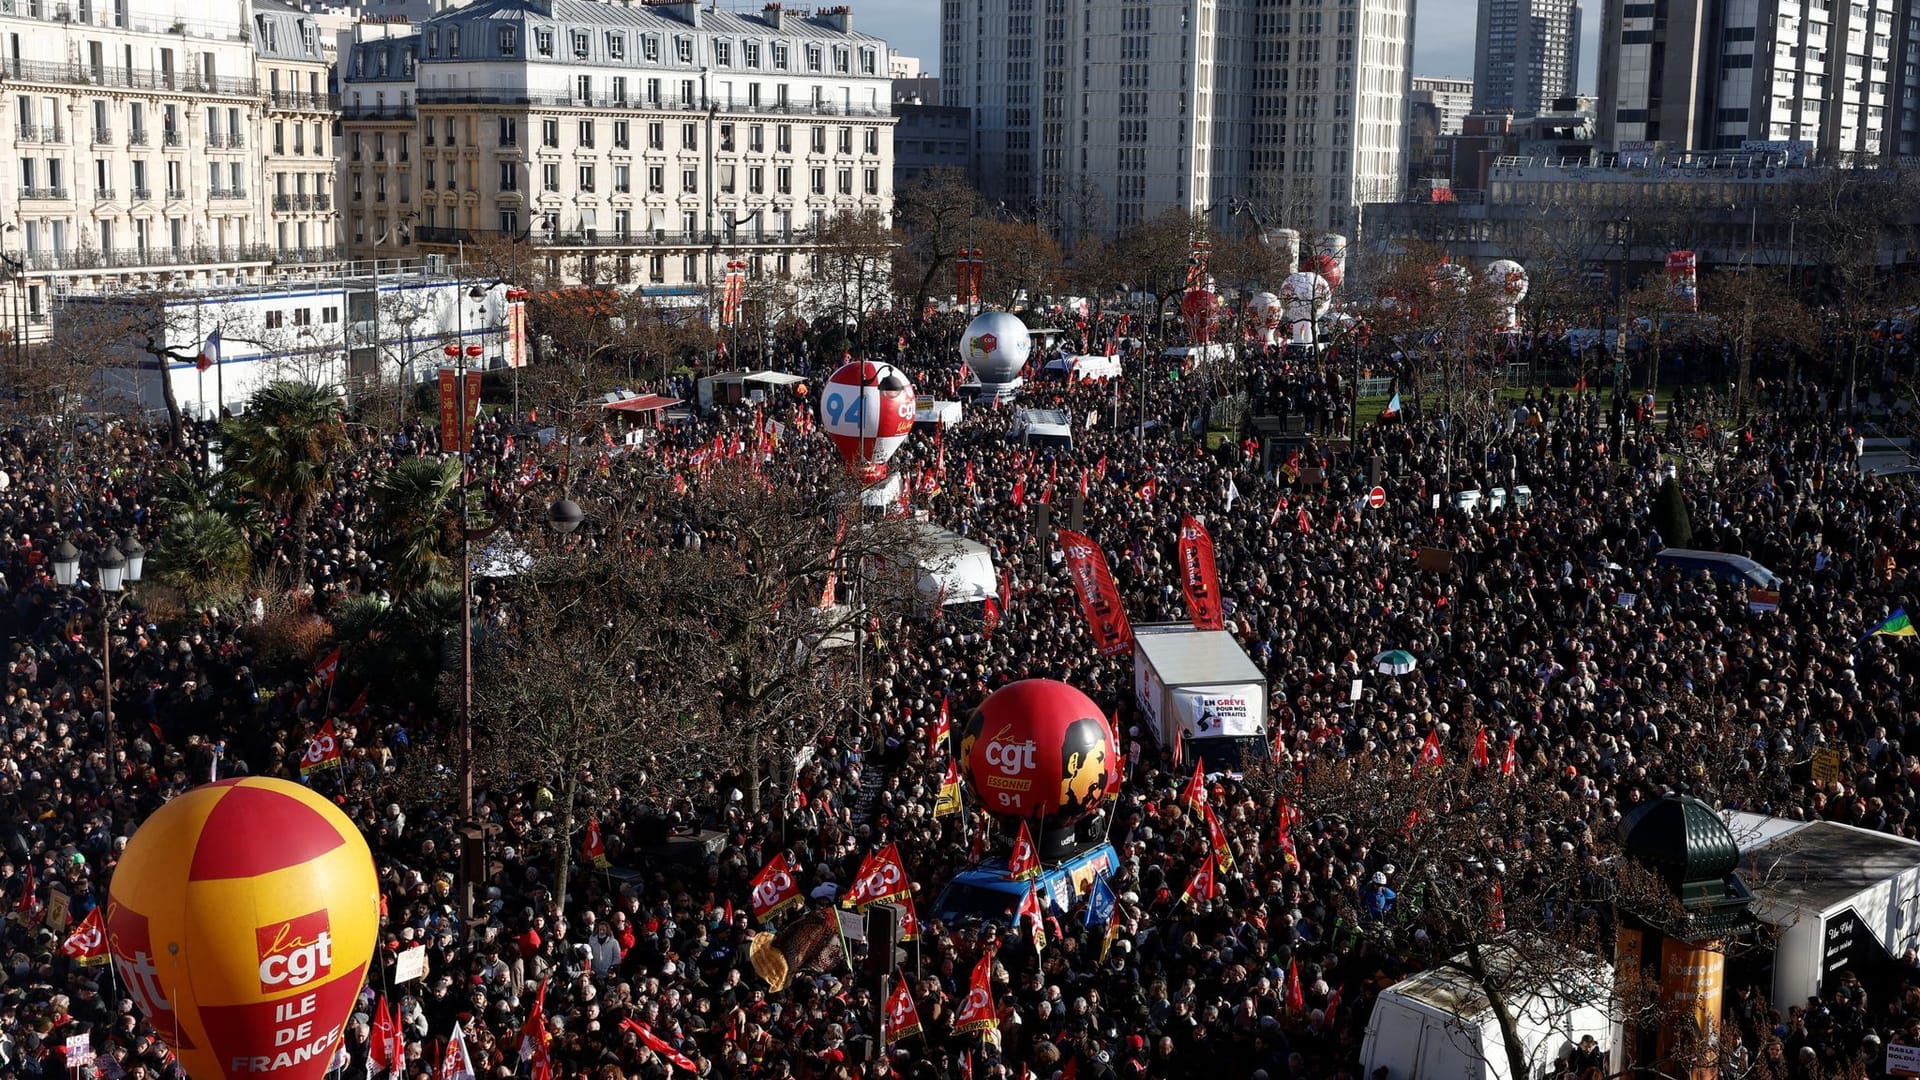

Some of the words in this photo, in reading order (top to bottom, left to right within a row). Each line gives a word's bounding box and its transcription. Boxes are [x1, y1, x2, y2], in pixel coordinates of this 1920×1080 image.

[826, 393, 868, 429] 94
[1217, 696, 1246, 706] GRÈVE
[985, 740, 1037, 775] cgt
[989, 776, 1031, 791] ESSONNE
[998, 792, 1021, 808] 91
[260, 931, 331, 985] cgt
[275, 993, 317, 1023] ILE
[231, 1024, 339, 1073] FRANCE
[275, 1020, 313, 1047] DE
